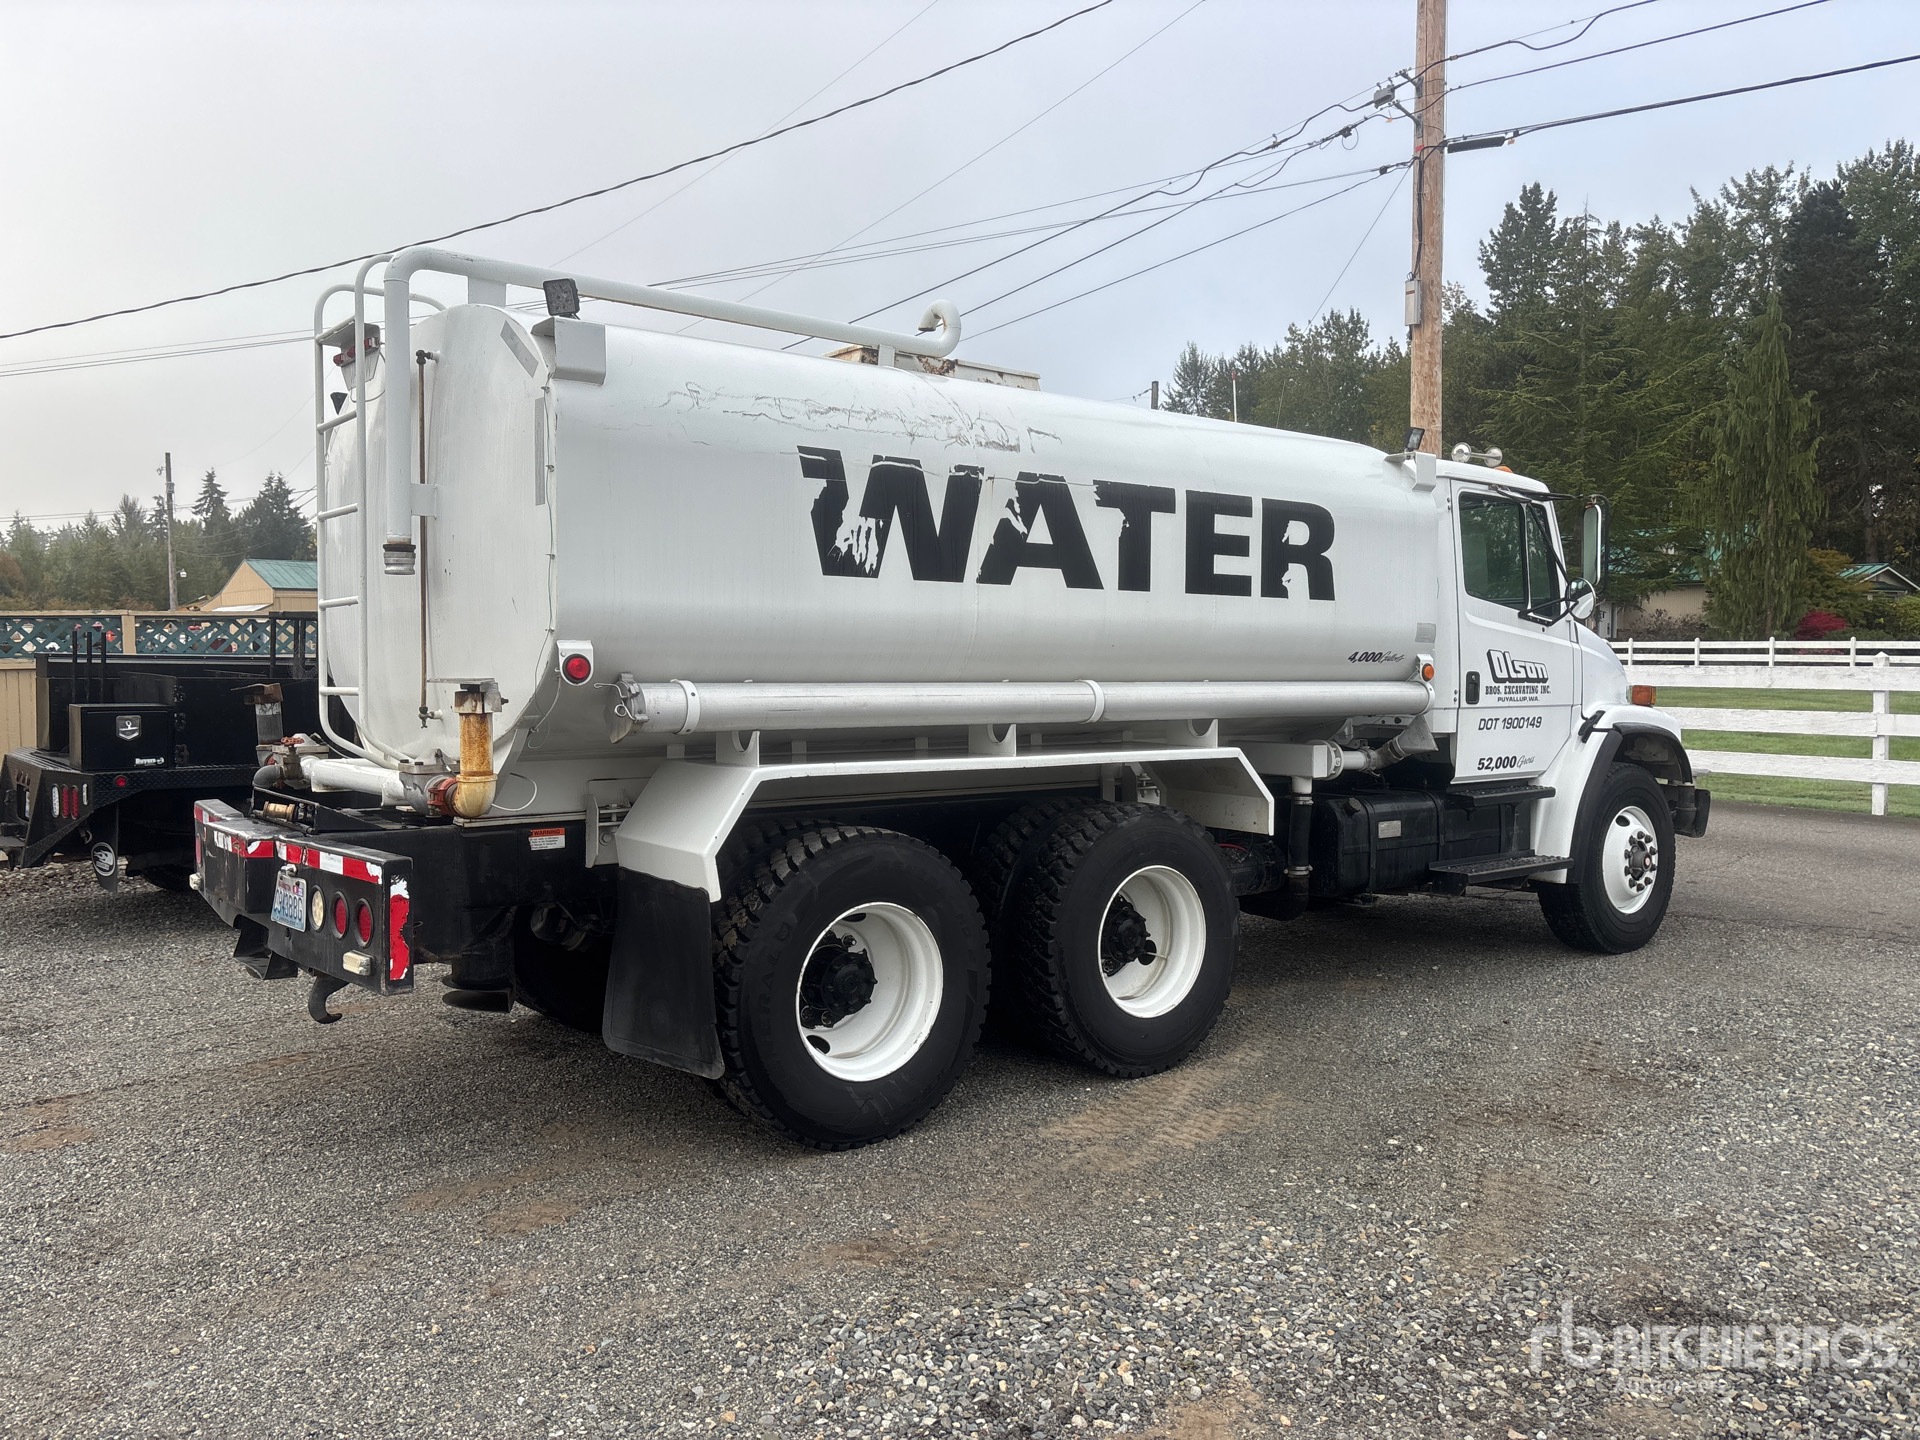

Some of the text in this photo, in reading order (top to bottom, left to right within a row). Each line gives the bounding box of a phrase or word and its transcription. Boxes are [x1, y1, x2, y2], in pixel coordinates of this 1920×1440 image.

[797, 445, 1335, 600] WATER
[1348, 651, 1383, 664] 4,000
[1486, 648, 1549, 684] Olson
[1485, 685, 1552, 695] BROS. EXCAVATING INC.
[1478, 716, 1542, 730] DOT 1900149
[1477, 755, 1517, 771] 52,000
